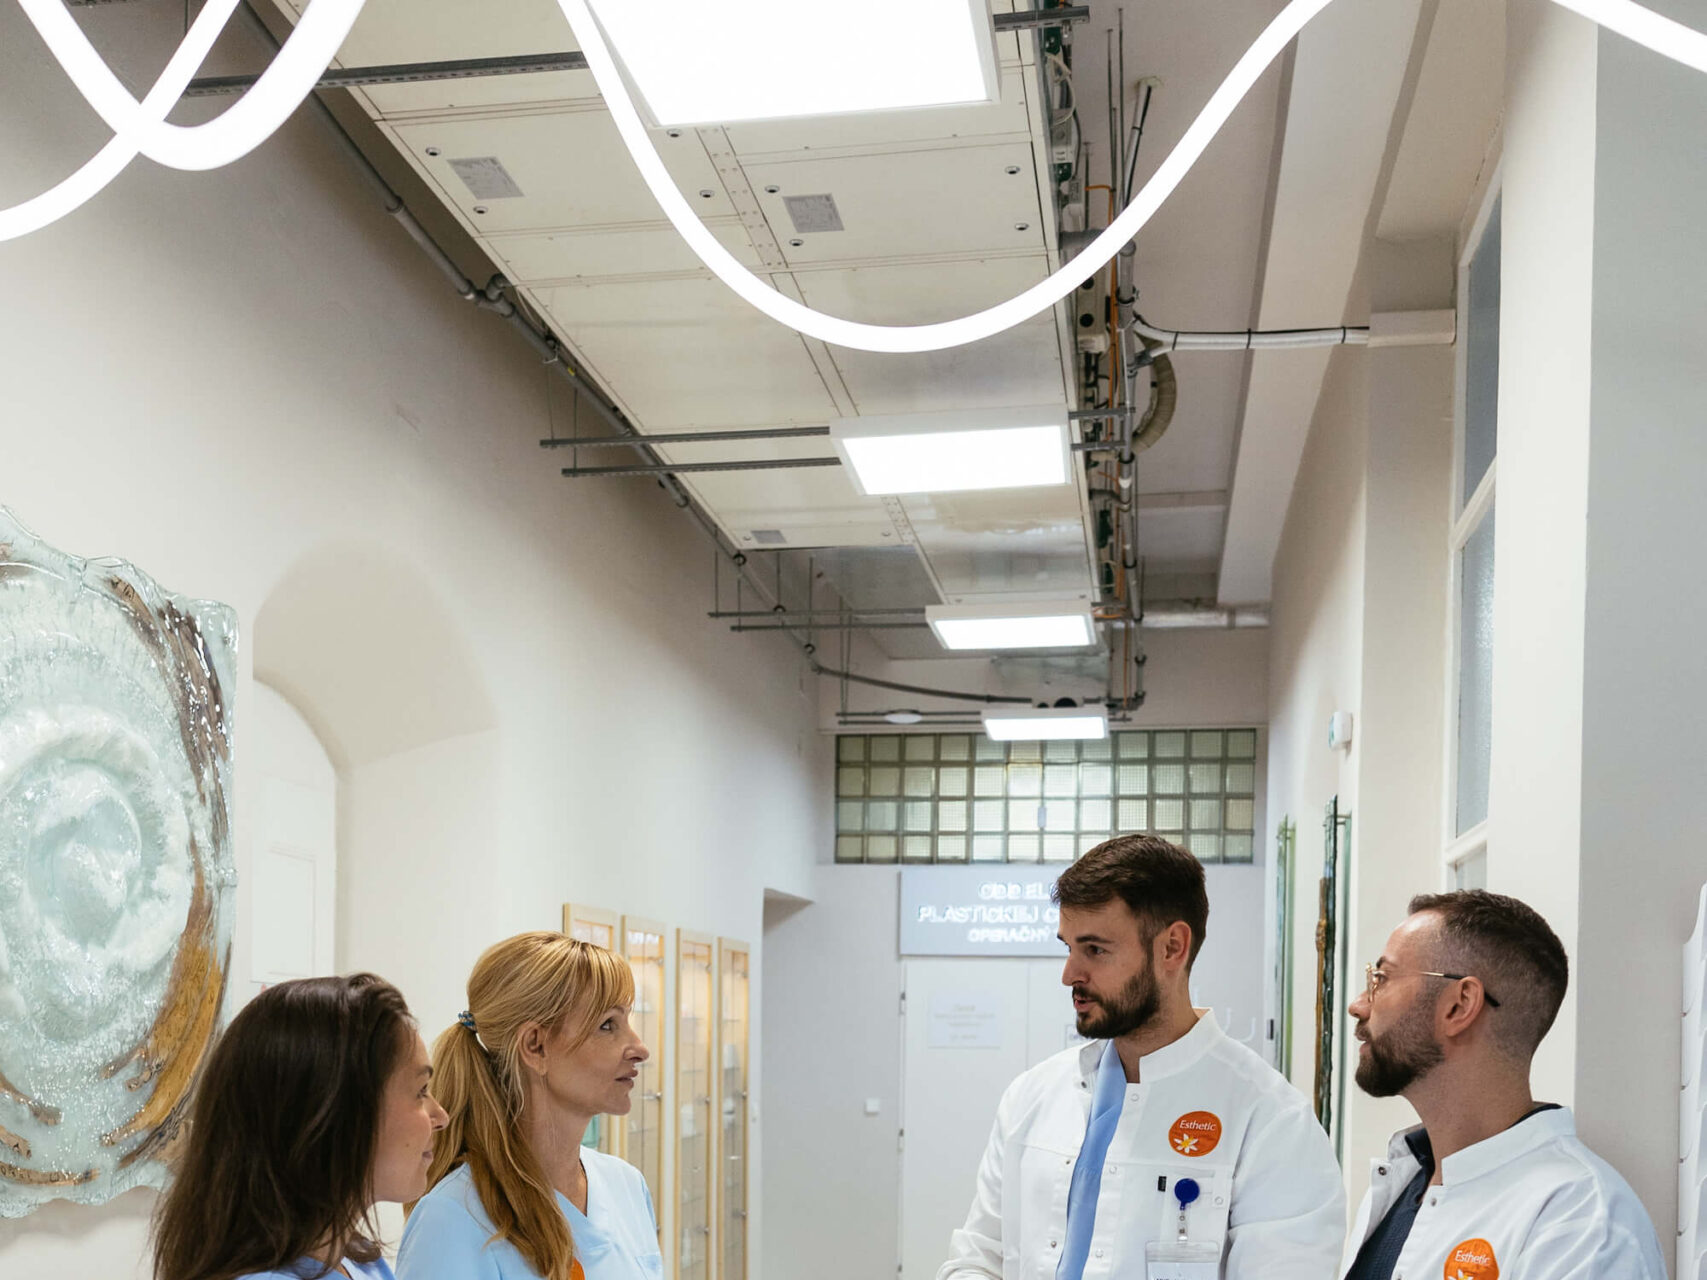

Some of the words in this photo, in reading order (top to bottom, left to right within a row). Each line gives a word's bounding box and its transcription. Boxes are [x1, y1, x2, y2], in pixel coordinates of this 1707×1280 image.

[918, 905, 1039, 923] PLASTICKEJ
[1180, 1119, 1217, 1131] Esthetic
[1455, 1249, 1491, 1267] Esthetic
